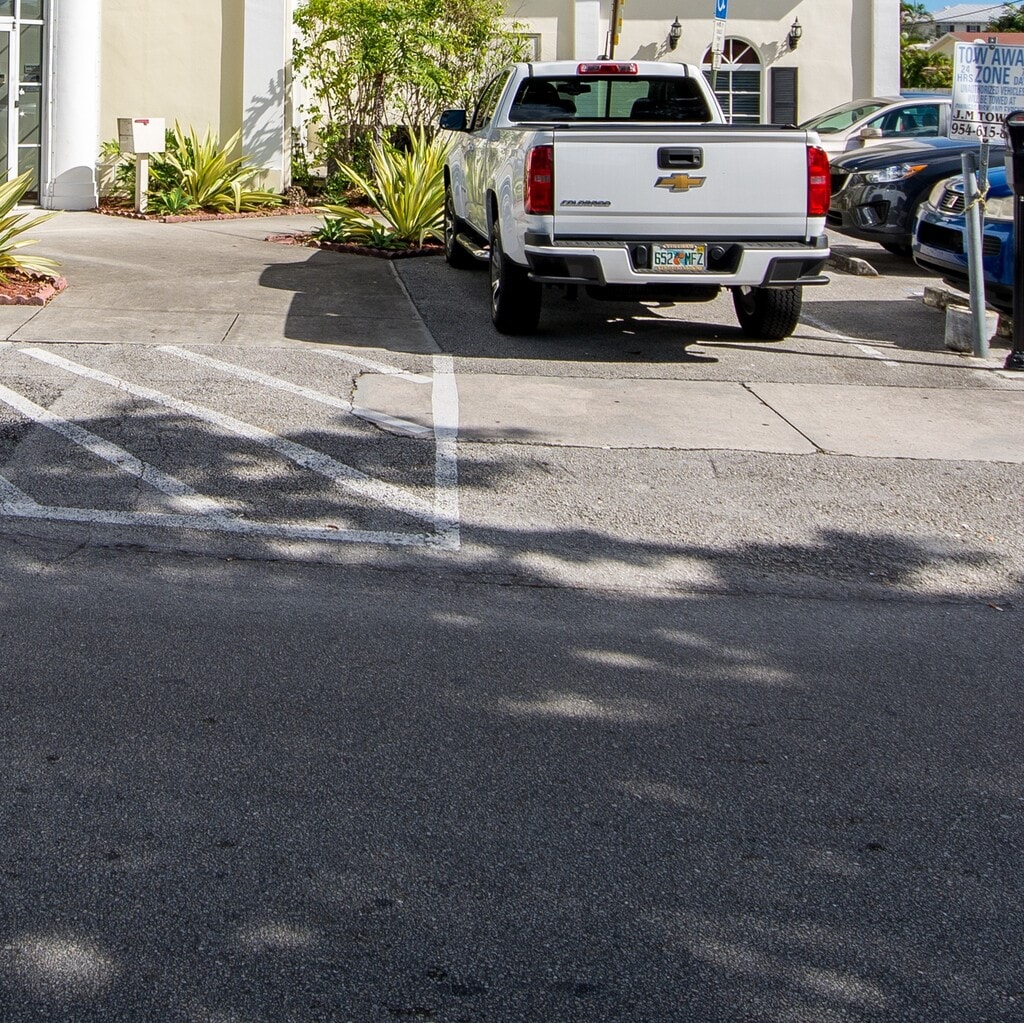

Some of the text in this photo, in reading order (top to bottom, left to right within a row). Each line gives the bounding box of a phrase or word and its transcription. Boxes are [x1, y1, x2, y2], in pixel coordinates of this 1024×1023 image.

[959, 46, 988, 65] TOW
[957, 73, 1024, 86] HRS DA
[961, 64, 970, 74] 24
[975, 65, 1010, 84] ZONE
[989, 95, 1008, 106] TOWED
[1009, 96, 1016, 106] AT
[953, 109, 974, 121] J.M
[654, 251, 704, 266] 652 MFZ
